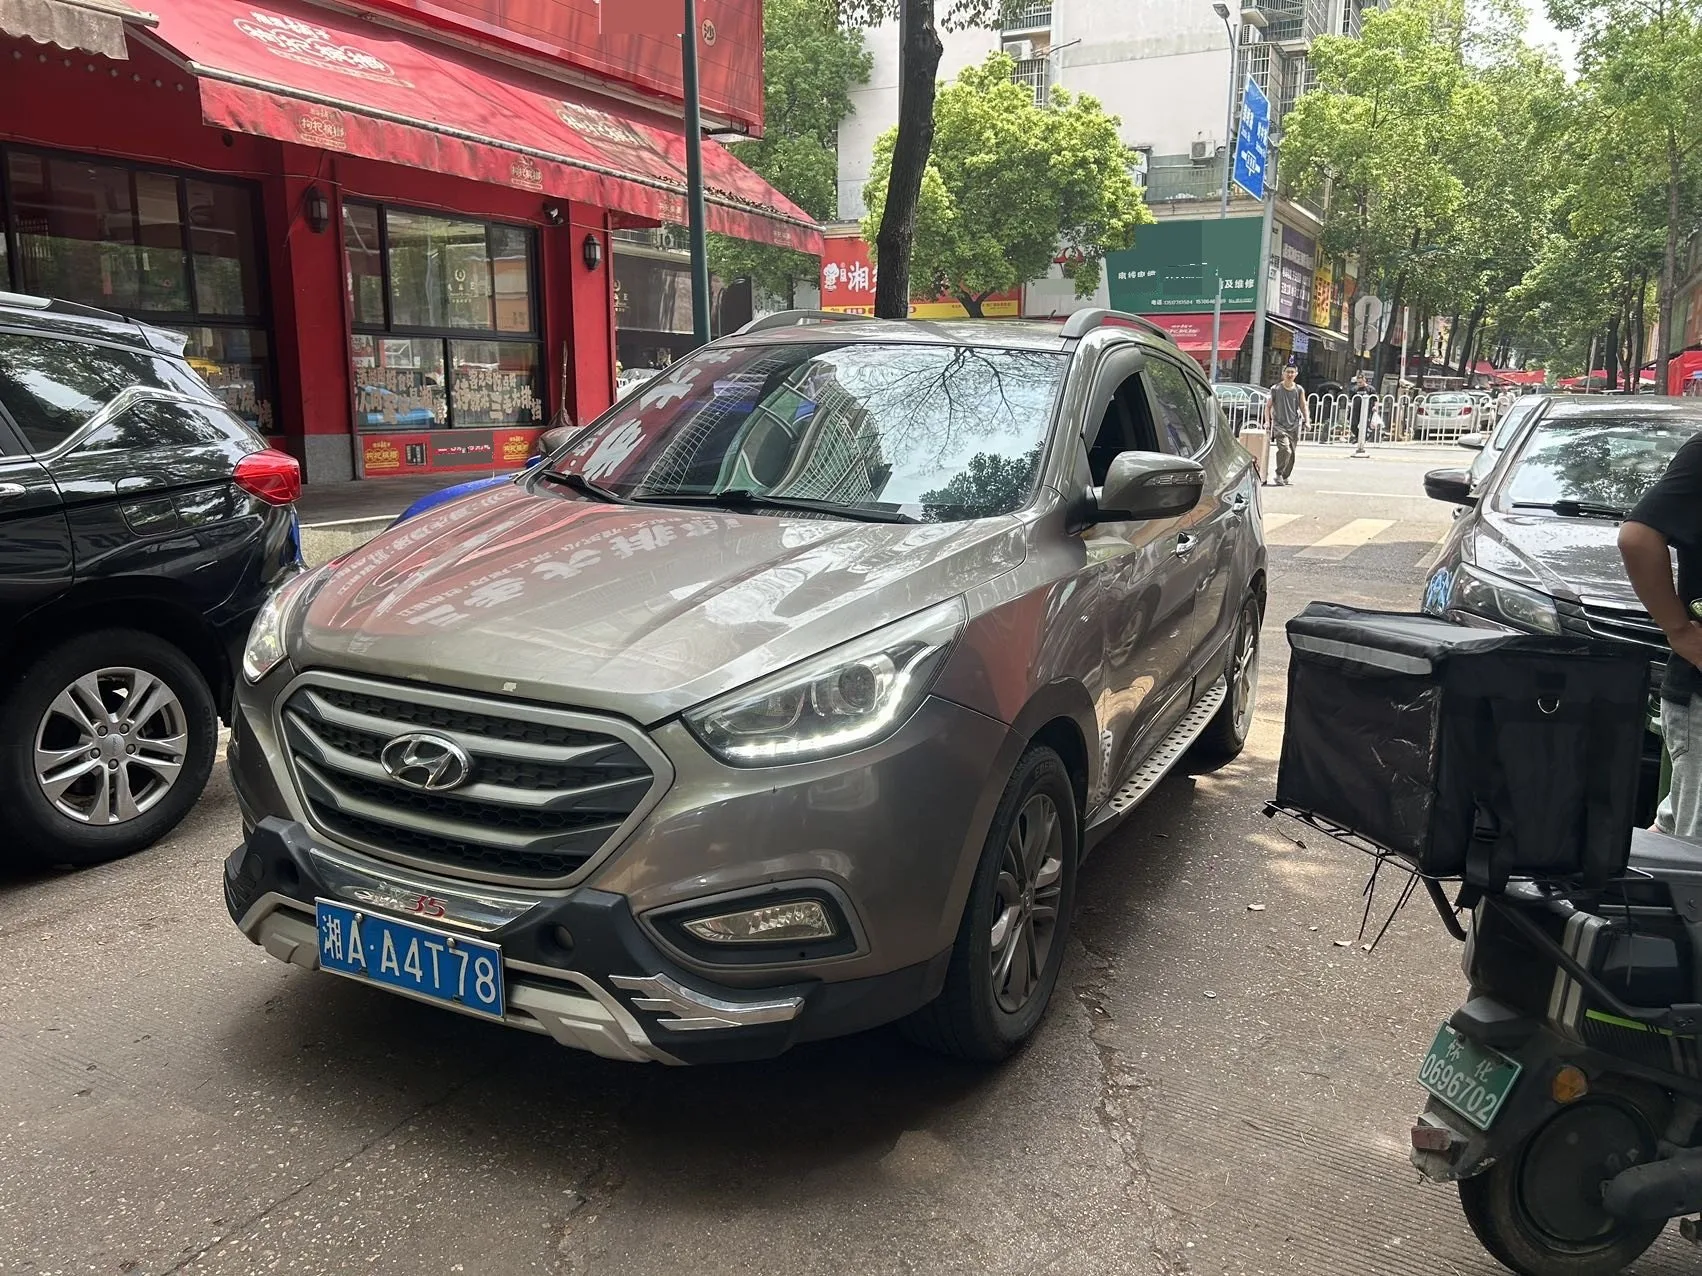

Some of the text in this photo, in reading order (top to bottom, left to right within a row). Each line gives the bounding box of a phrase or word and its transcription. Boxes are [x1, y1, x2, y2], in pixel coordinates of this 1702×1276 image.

[704, 24, 714, 41] 沙
[322, 914, 497, 1004] 湘A·A4T78
[1421, 1053, 1498, 1122] 0696702
